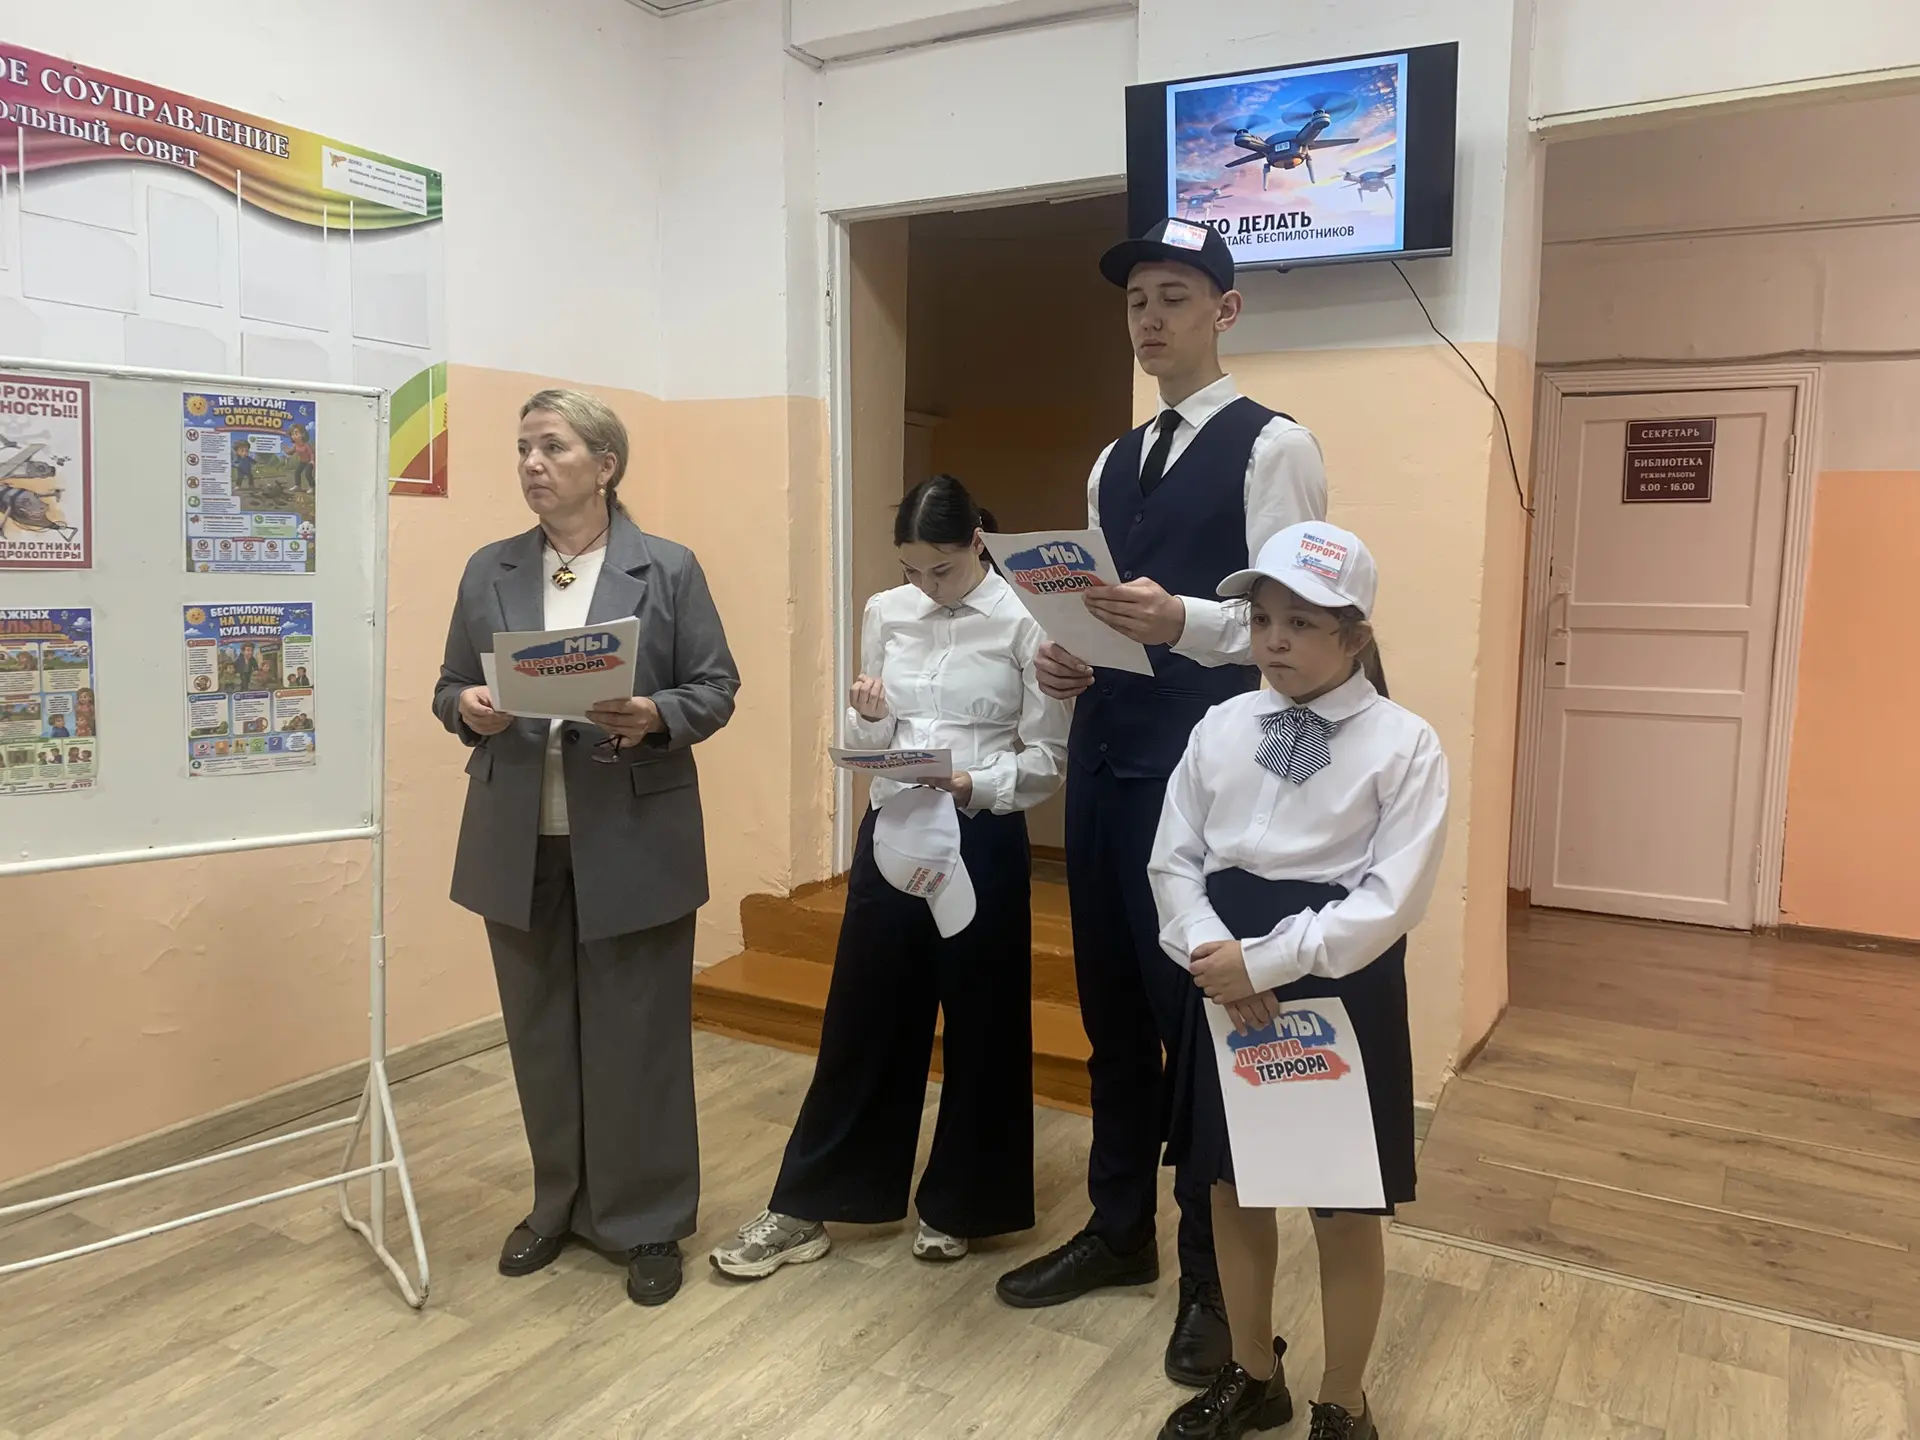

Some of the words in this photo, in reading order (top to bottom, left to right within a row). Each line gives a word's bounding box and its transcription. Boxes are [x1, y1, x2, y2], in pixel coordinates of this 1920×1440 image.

[0, 57, 28, 86] Е
[40, 67, 290, 159] СОУПРАВЛЕНИЕ
[119, 131, 199, 169] СОВЕТ
[1238, 211, 1312, 235] ДЕЛАТЬ
[1256, 226, 1355, 244] БЕСПИЛОТНИКОВ
[0, 385, 78, 403] РОЖНО
[218, 397, 234, 406] НЕ
[237, 397, 286, 410] ТРОГАЙ!
[213, 407, 232, 415] ЭТО
[233, 408, 267, 416] МОЖЕТ
[269, 410, 293, 420] БЫТЬ
[225, 415, 282, 428] ОПАСНО
[1641, 428, 1700, 438] СЕКРЕТАРЬ
[1634, 457, 1703, 467] БИБЛИОТЕКА
[1640, 483, 1660, 491] 8.00
[1670, 482, 1695, 491] 16.00
[1037, 545, 1084, 564] МЫ
[1300, 540, 1346, 561] ТЕРРОРА!
[1015, 566, 1070, 582] ПРОТИВ
[1033, 576, 1093, 593] ТЕРРОРА
[210, 606, 285, 617] БЕСПИЛОТНИК
[220, 616, 235, 625] НА
[239, 616, 280, 625] УЛИЦЕ:
[220, 627, 247, 636] КУДА
[250, 626, 282, 636] ИДТИ?
[564, 634, 609, 653] МЫ
[520, 653, 586, 668] ПРОТИВ
[537, 659, 605, 675] ТЕРРОРА
[1274, 1013, 1322, 1037] МЫ
[1236, 1041, 1302, 1066] ПРОТИВ
[1256, 1055, 1328, 1082] ТЕРРОРА
